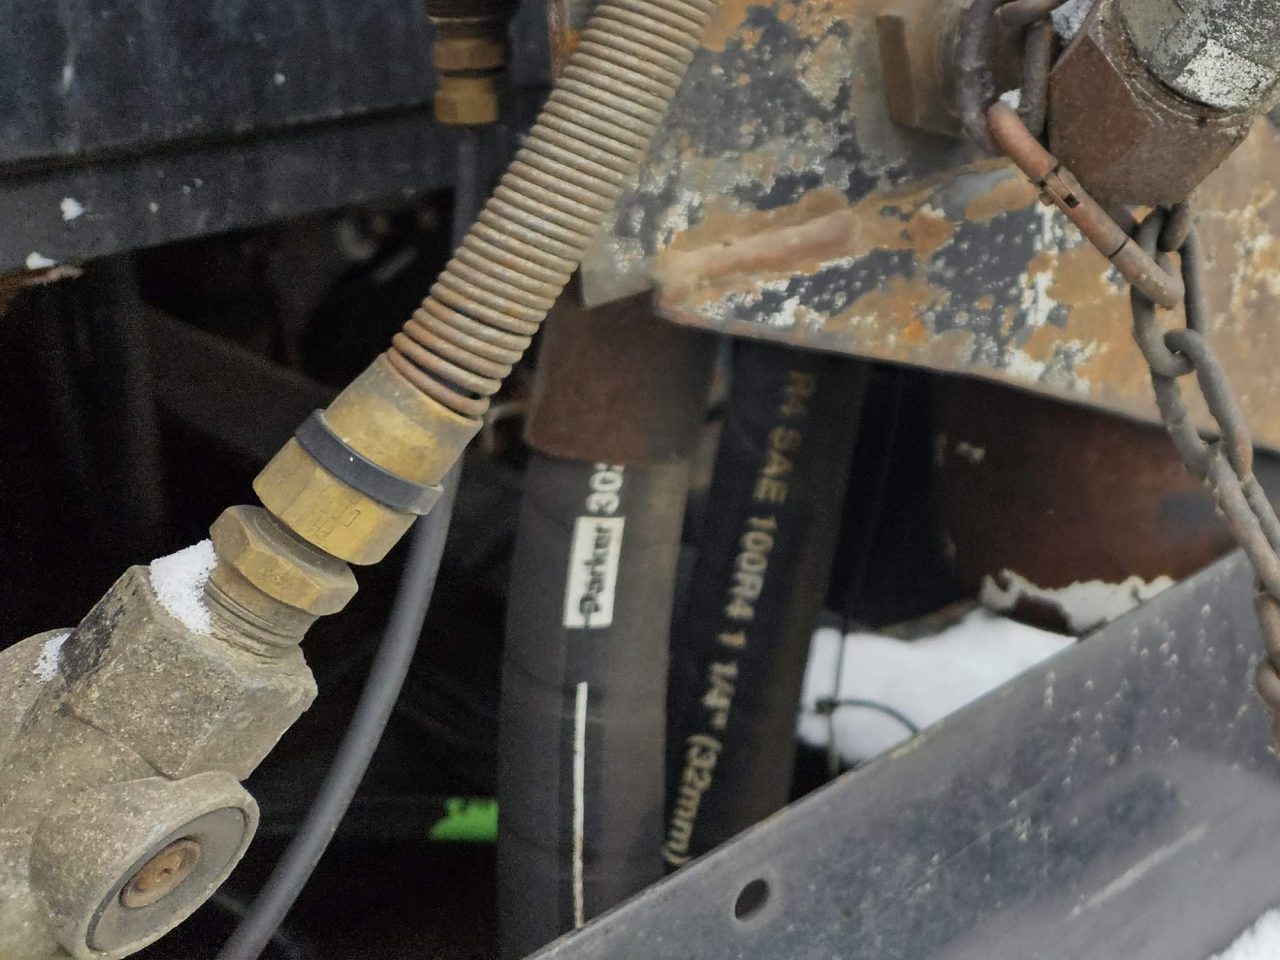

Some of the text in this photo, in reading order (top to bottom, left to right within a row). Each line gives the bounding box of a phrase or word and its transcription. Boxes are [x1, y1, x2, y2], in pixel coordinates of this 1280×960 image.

[753, 426, 801, 504] SAE
[578, 526, 612, 622] Parker
[725, 515, 777, 620] 100R4
[717, 630, 748, 648] 1
[661, 734, 723, 865] (32mm)
